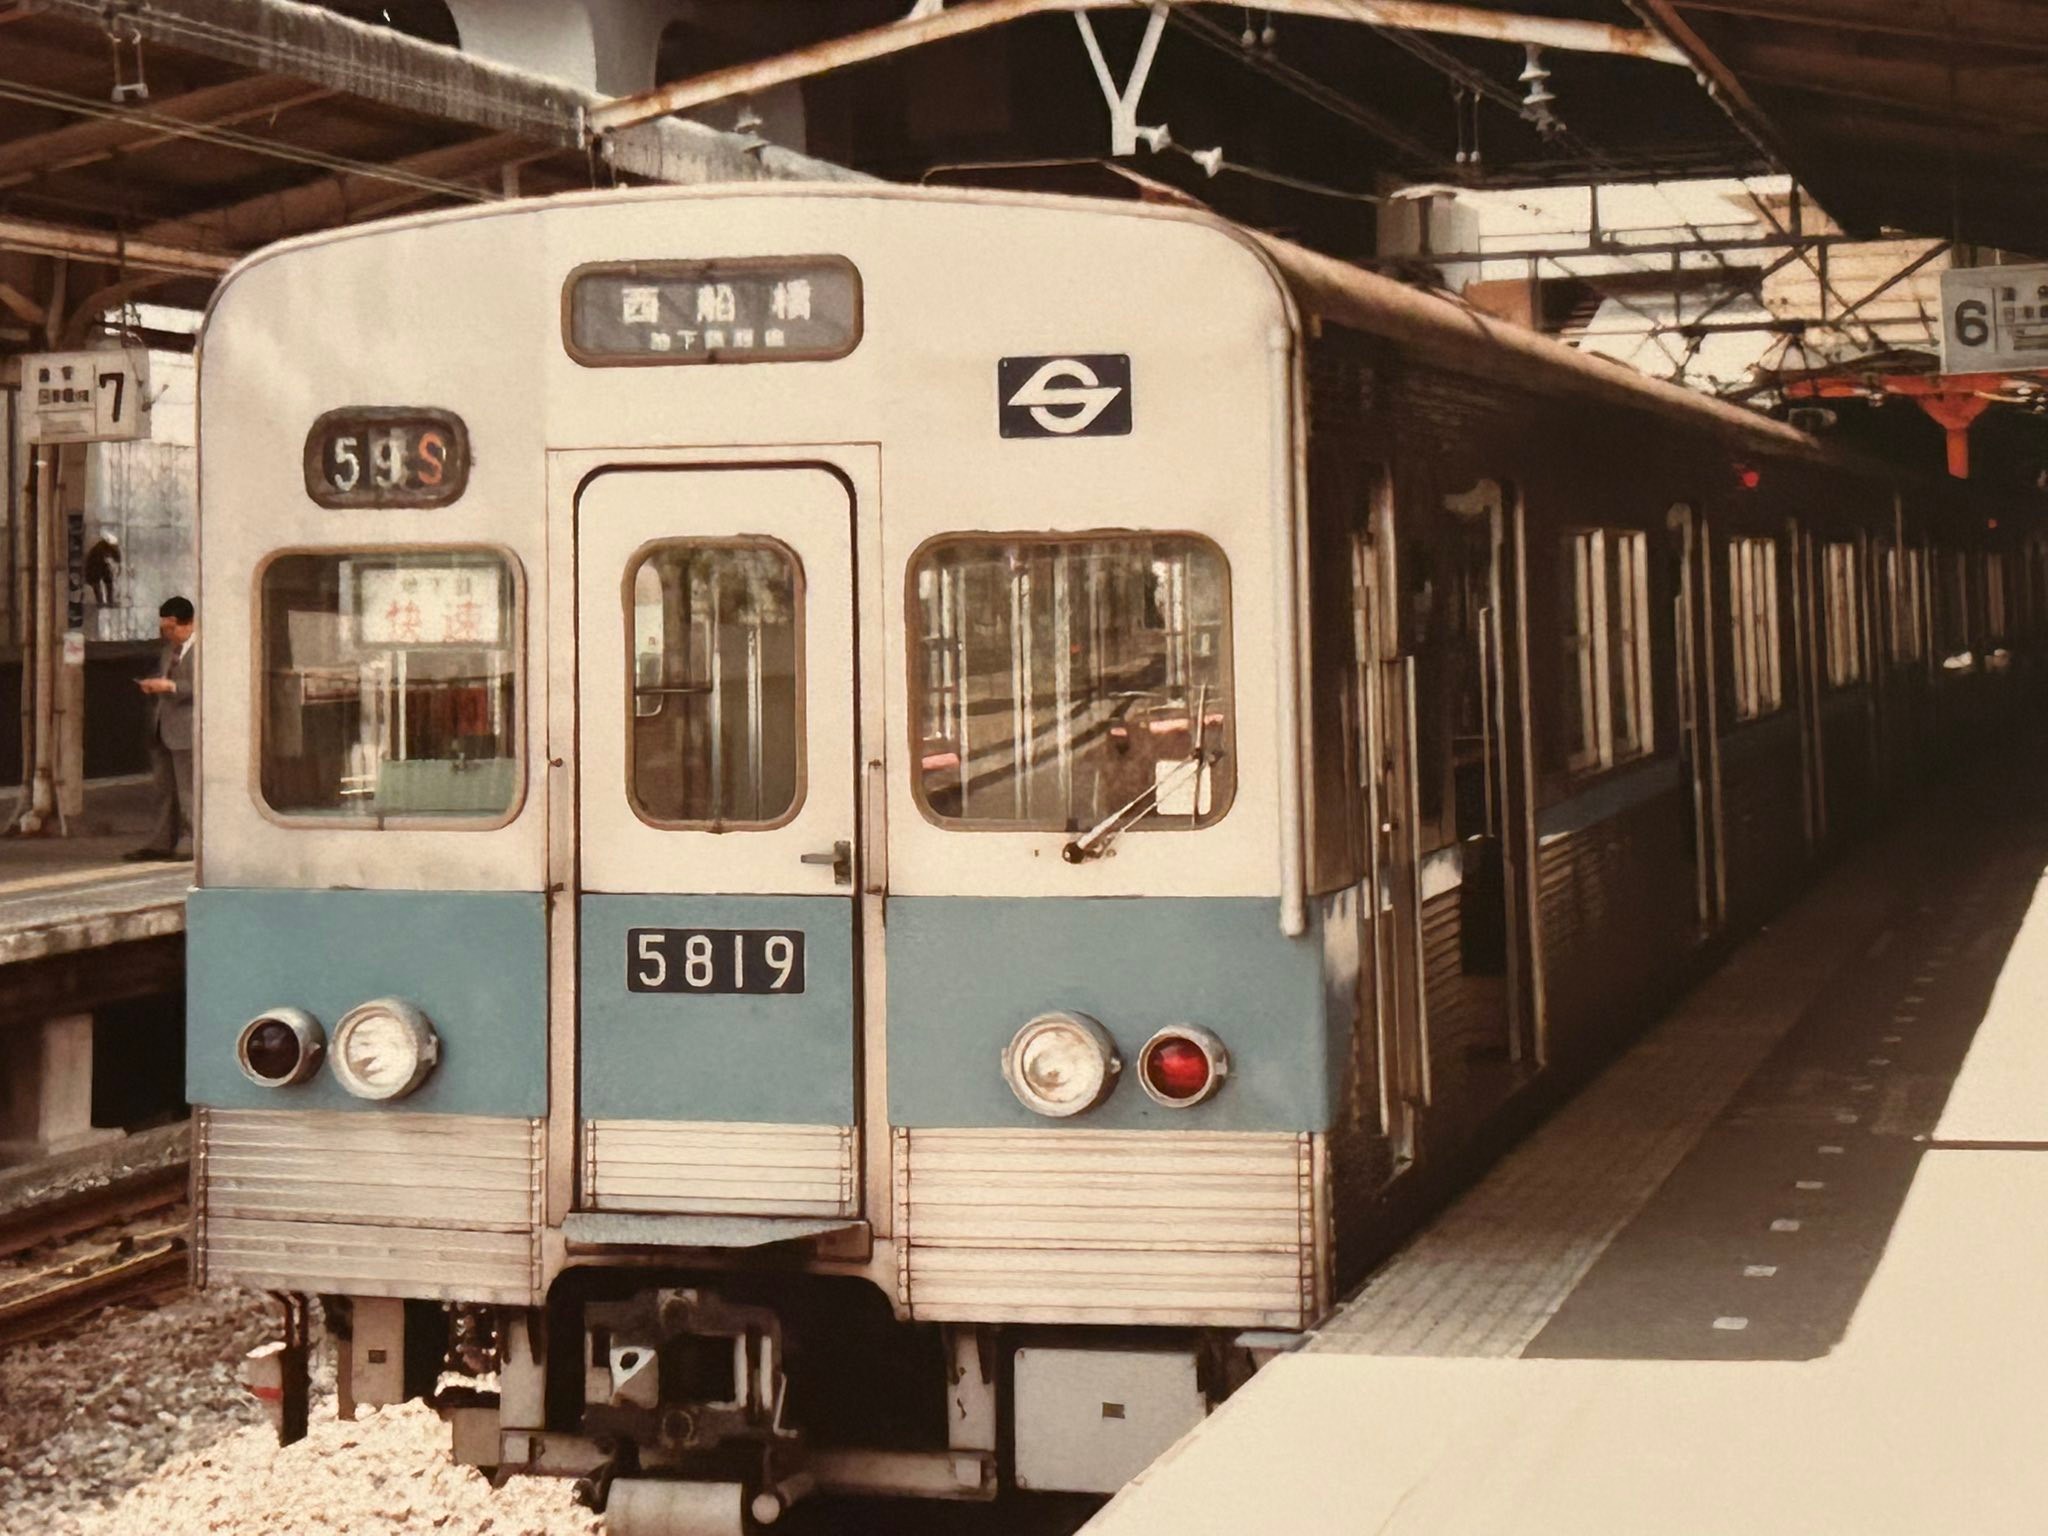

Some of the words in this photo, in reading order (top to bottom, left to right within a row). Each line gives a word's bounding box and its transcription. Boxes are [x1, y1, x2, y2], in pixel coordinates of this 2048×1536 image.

[1954, 299, 1989, 347] 6
[98, 372, 125, 423] 7
[638, 934, 794, 988] 5819
